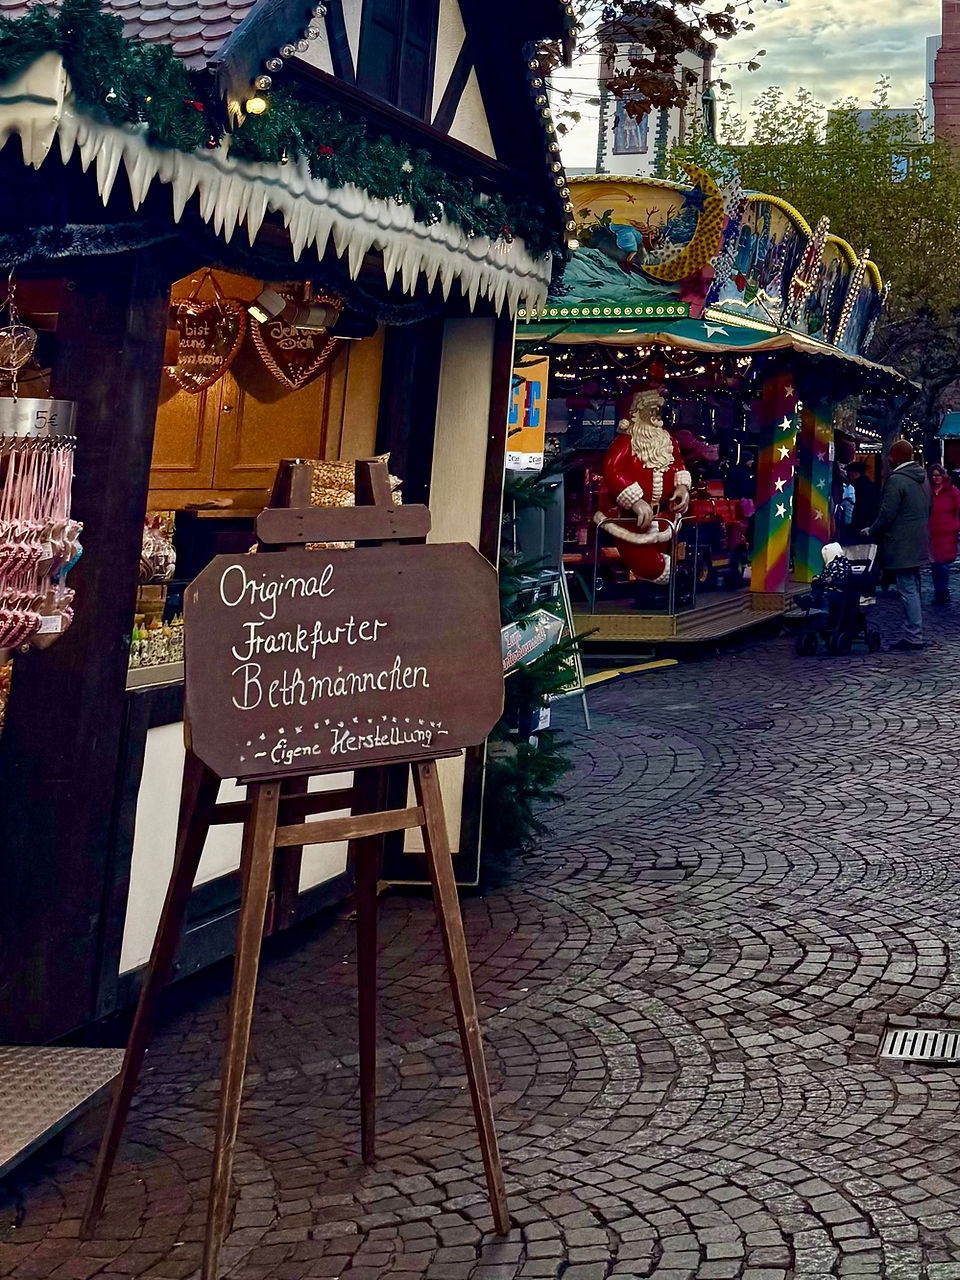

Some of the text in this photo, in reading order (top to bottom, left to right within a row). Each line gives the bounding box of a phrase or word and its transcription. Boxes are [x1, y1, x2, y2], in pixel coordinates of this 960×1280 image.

[34, 410, 58, 429] 5€
[220, 564, 335, 620] Original
[232, 616, 388, 661] Frankfurter
[271, 726, 433, 765] Eigene Herstellung
